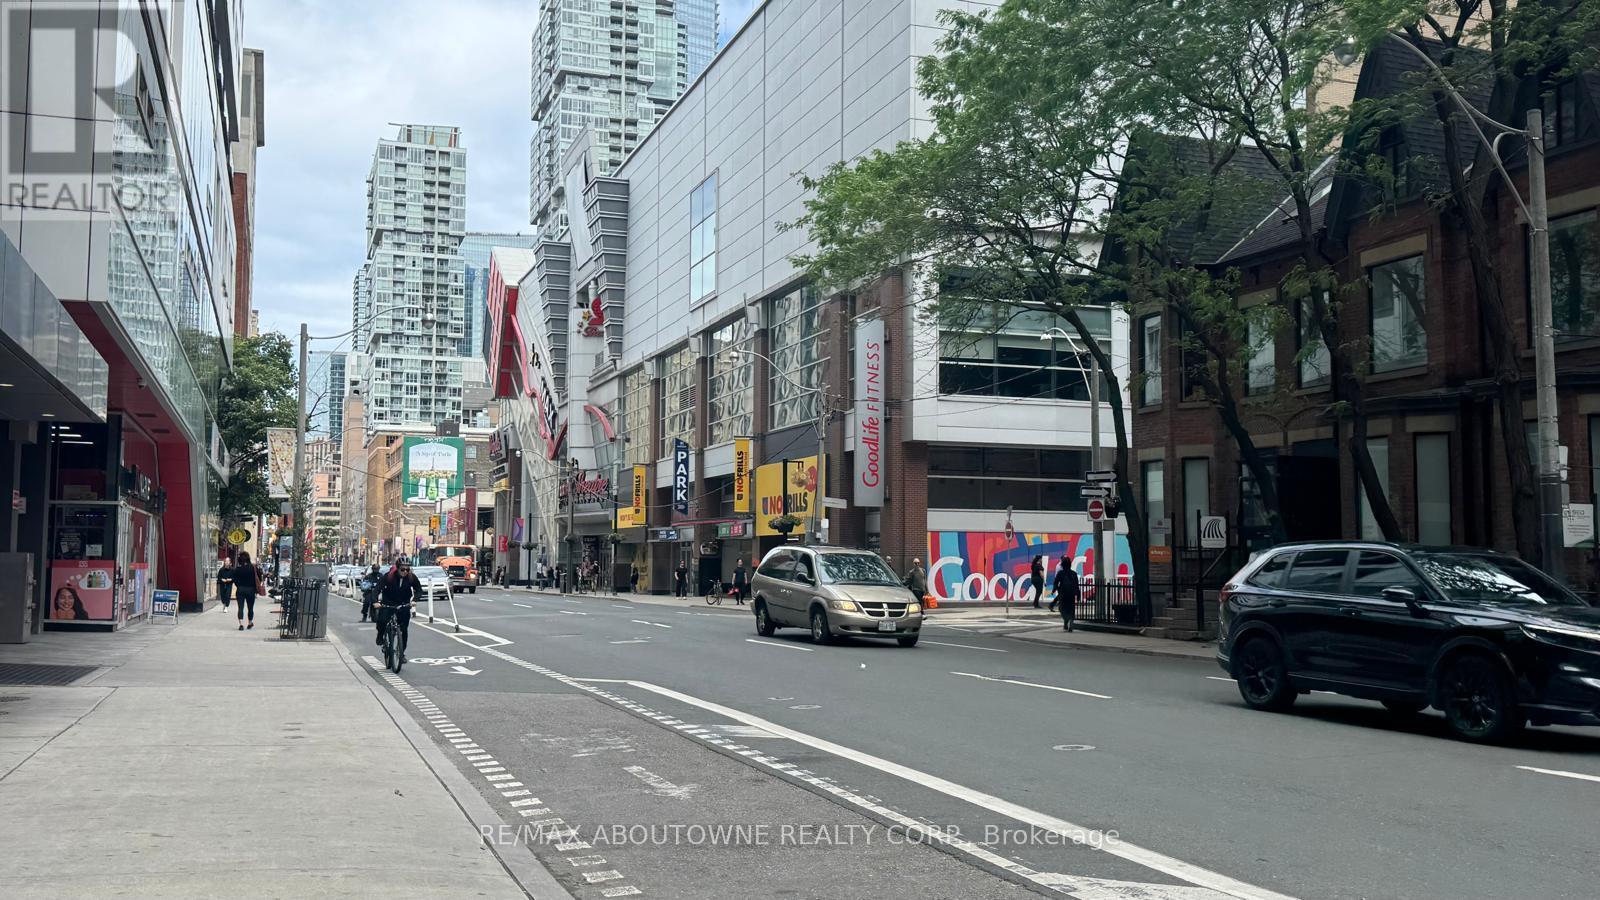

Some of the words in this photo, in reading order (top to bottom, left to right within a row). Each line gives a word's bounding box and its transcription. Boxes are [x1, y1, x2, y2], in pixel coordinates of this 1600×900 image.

[866, 341, 880, 411] FITNESS
[676, 451, 688, 501] PARK
[862, 416, 880, 488] GoodLife
[769, 491, 808, 515] NORILLS
